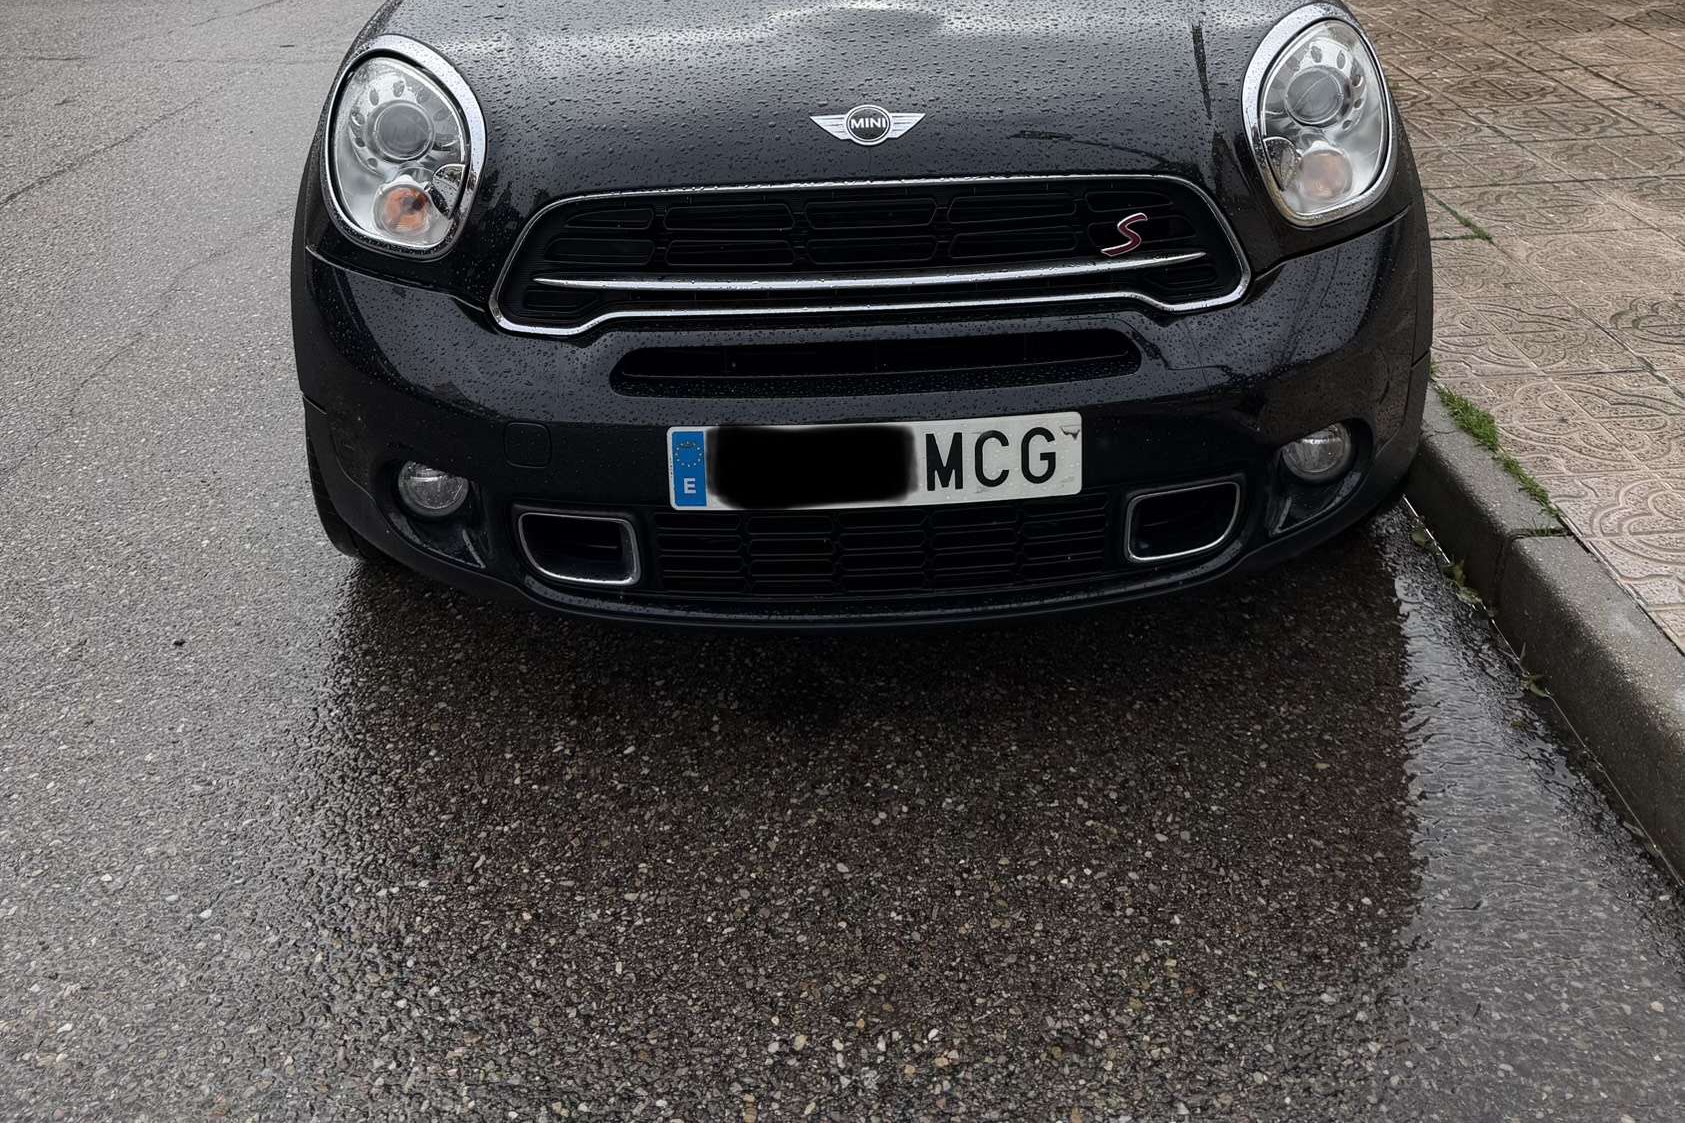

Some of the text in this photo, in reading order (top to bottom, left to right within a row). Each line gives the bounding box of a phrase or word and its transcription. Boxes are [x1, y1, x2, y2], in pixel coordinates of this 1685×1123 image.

[850, 117, 887, 129] MINI
[1101, 212, 1148, 256] S
[925, 426, 1057, 491] MCG
[683, 477, 697, 495] E
